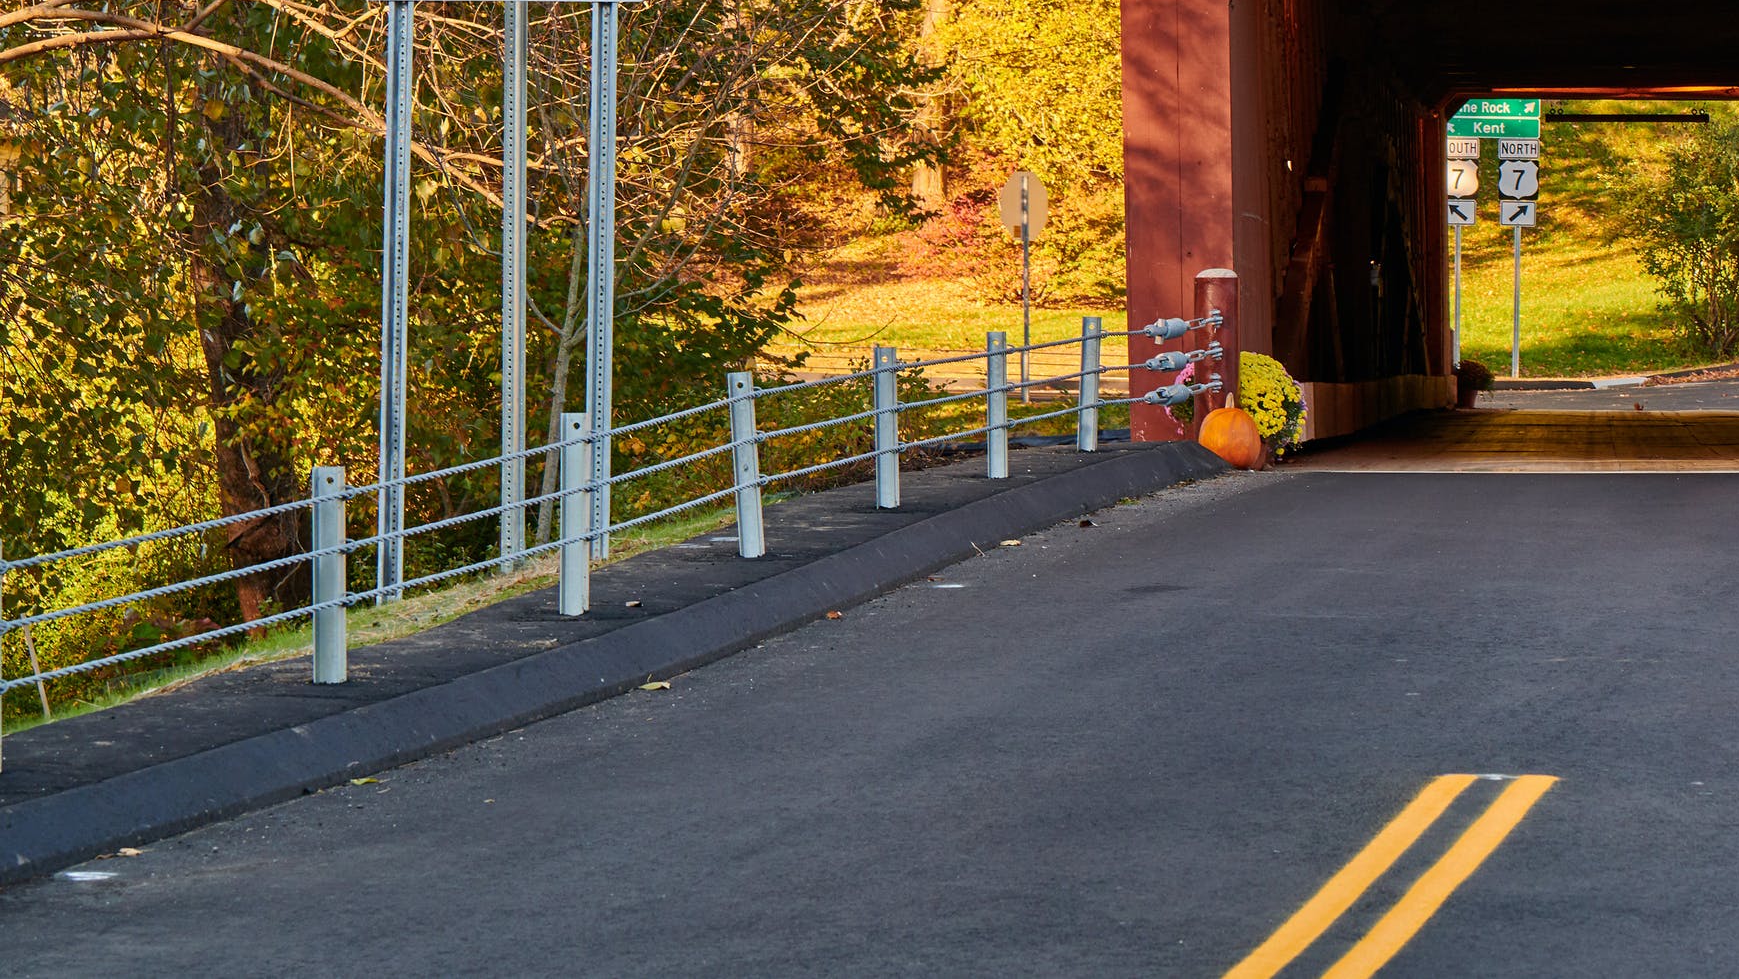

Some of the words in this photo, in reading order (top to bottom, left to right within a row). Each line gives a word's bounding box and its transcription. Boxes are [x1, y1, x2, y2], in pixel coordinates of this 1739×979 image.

[1481, 101, 1511, 114] Rock
[1473, 121, 1506, 134] Kent
[1449, 142, 1477, 154] OUTH
[1501, 142, 1537, 155] NORTH
[1452, 168, 1465, 190] 7
[1512, 169, 1526, 191] 7
